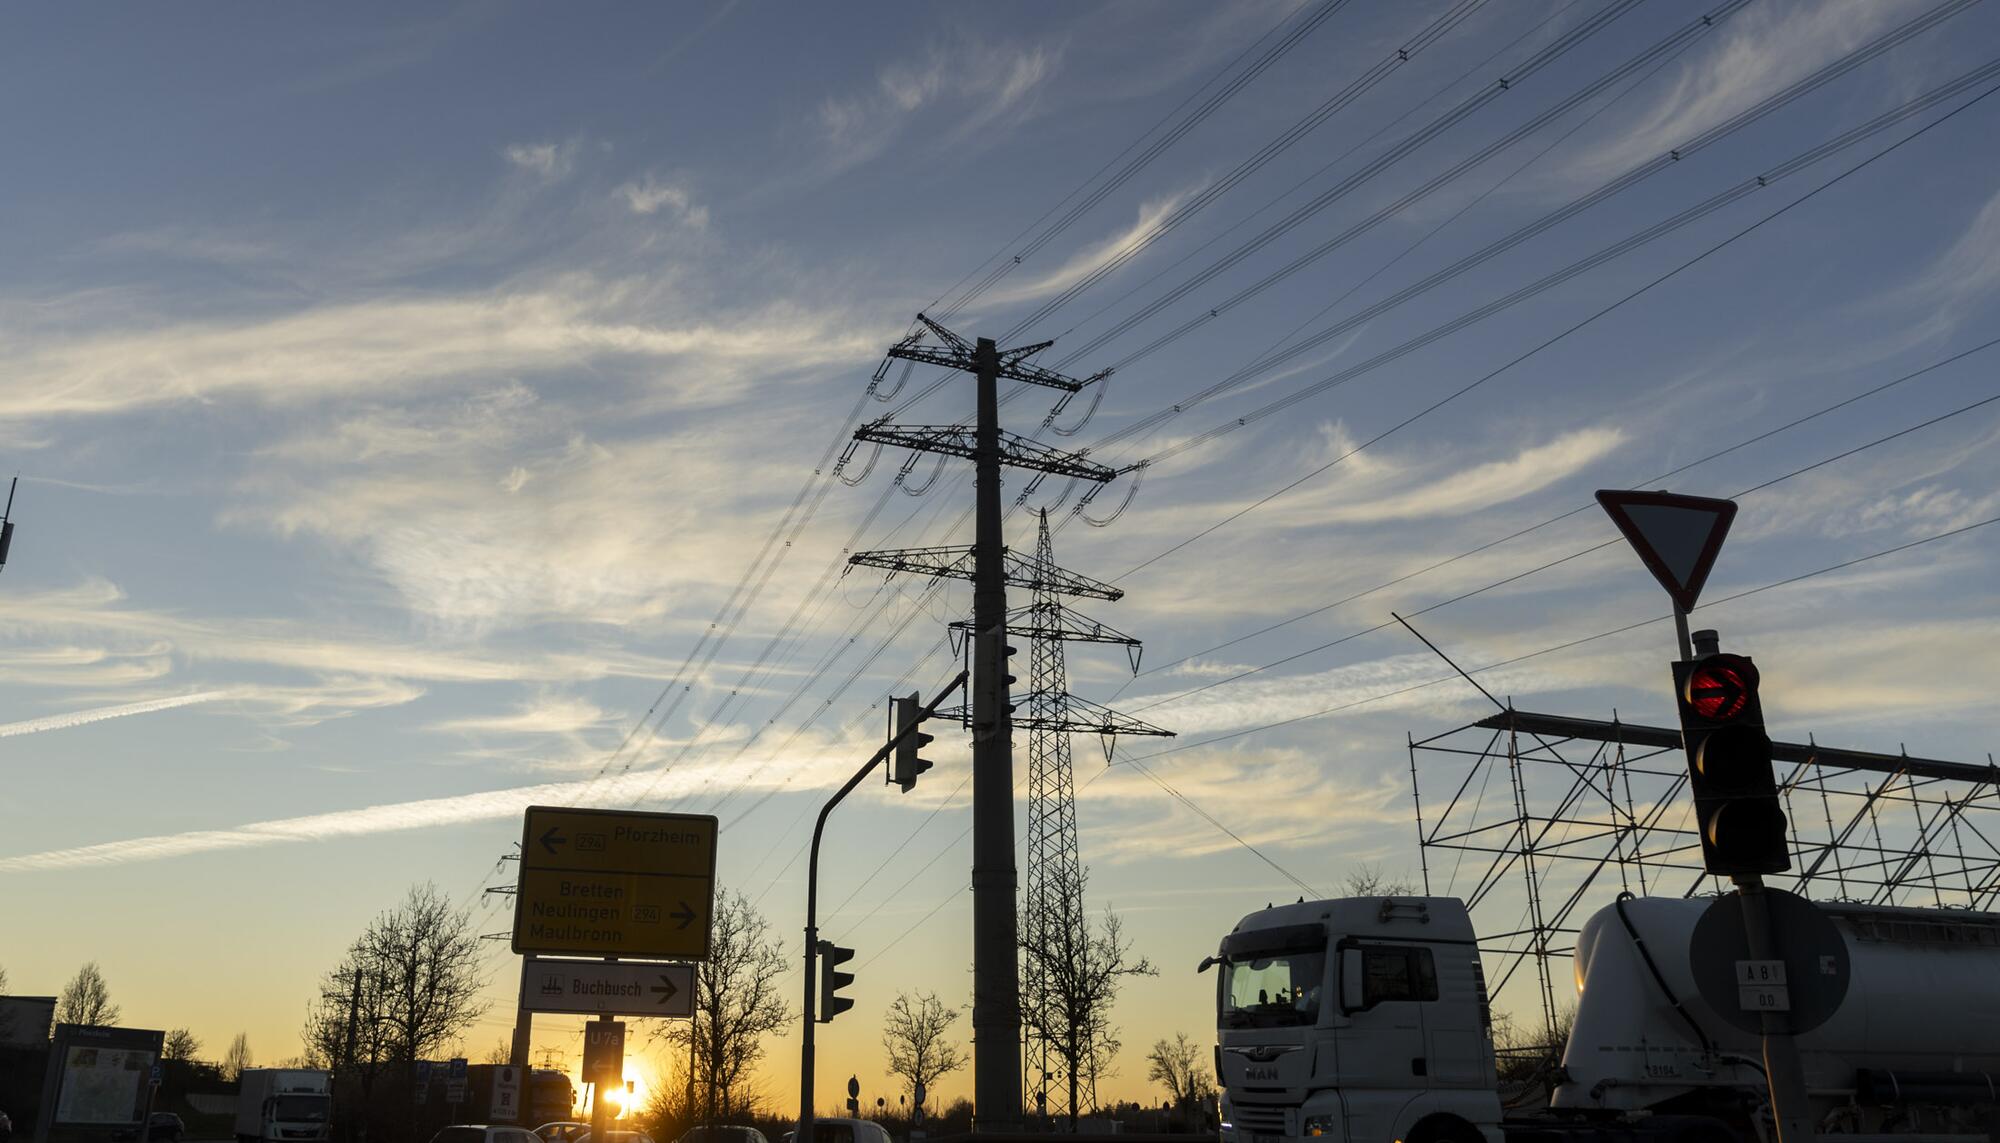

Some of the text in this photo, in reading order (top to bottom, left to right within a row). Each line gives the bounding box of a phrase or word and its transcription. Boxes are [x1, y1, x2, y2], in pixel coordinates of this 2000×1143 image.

[579, 827, 701, 848] 294 Pforzheim
[560, 880, 624, 899] Bretten
[532, 902, 657, 922] Neulingen 294
[530, 924, 624, 943] Maulbronn
[573, 979, 641, 997] Buchbusch
[1245, 1067, 1279, 1081] MAN
